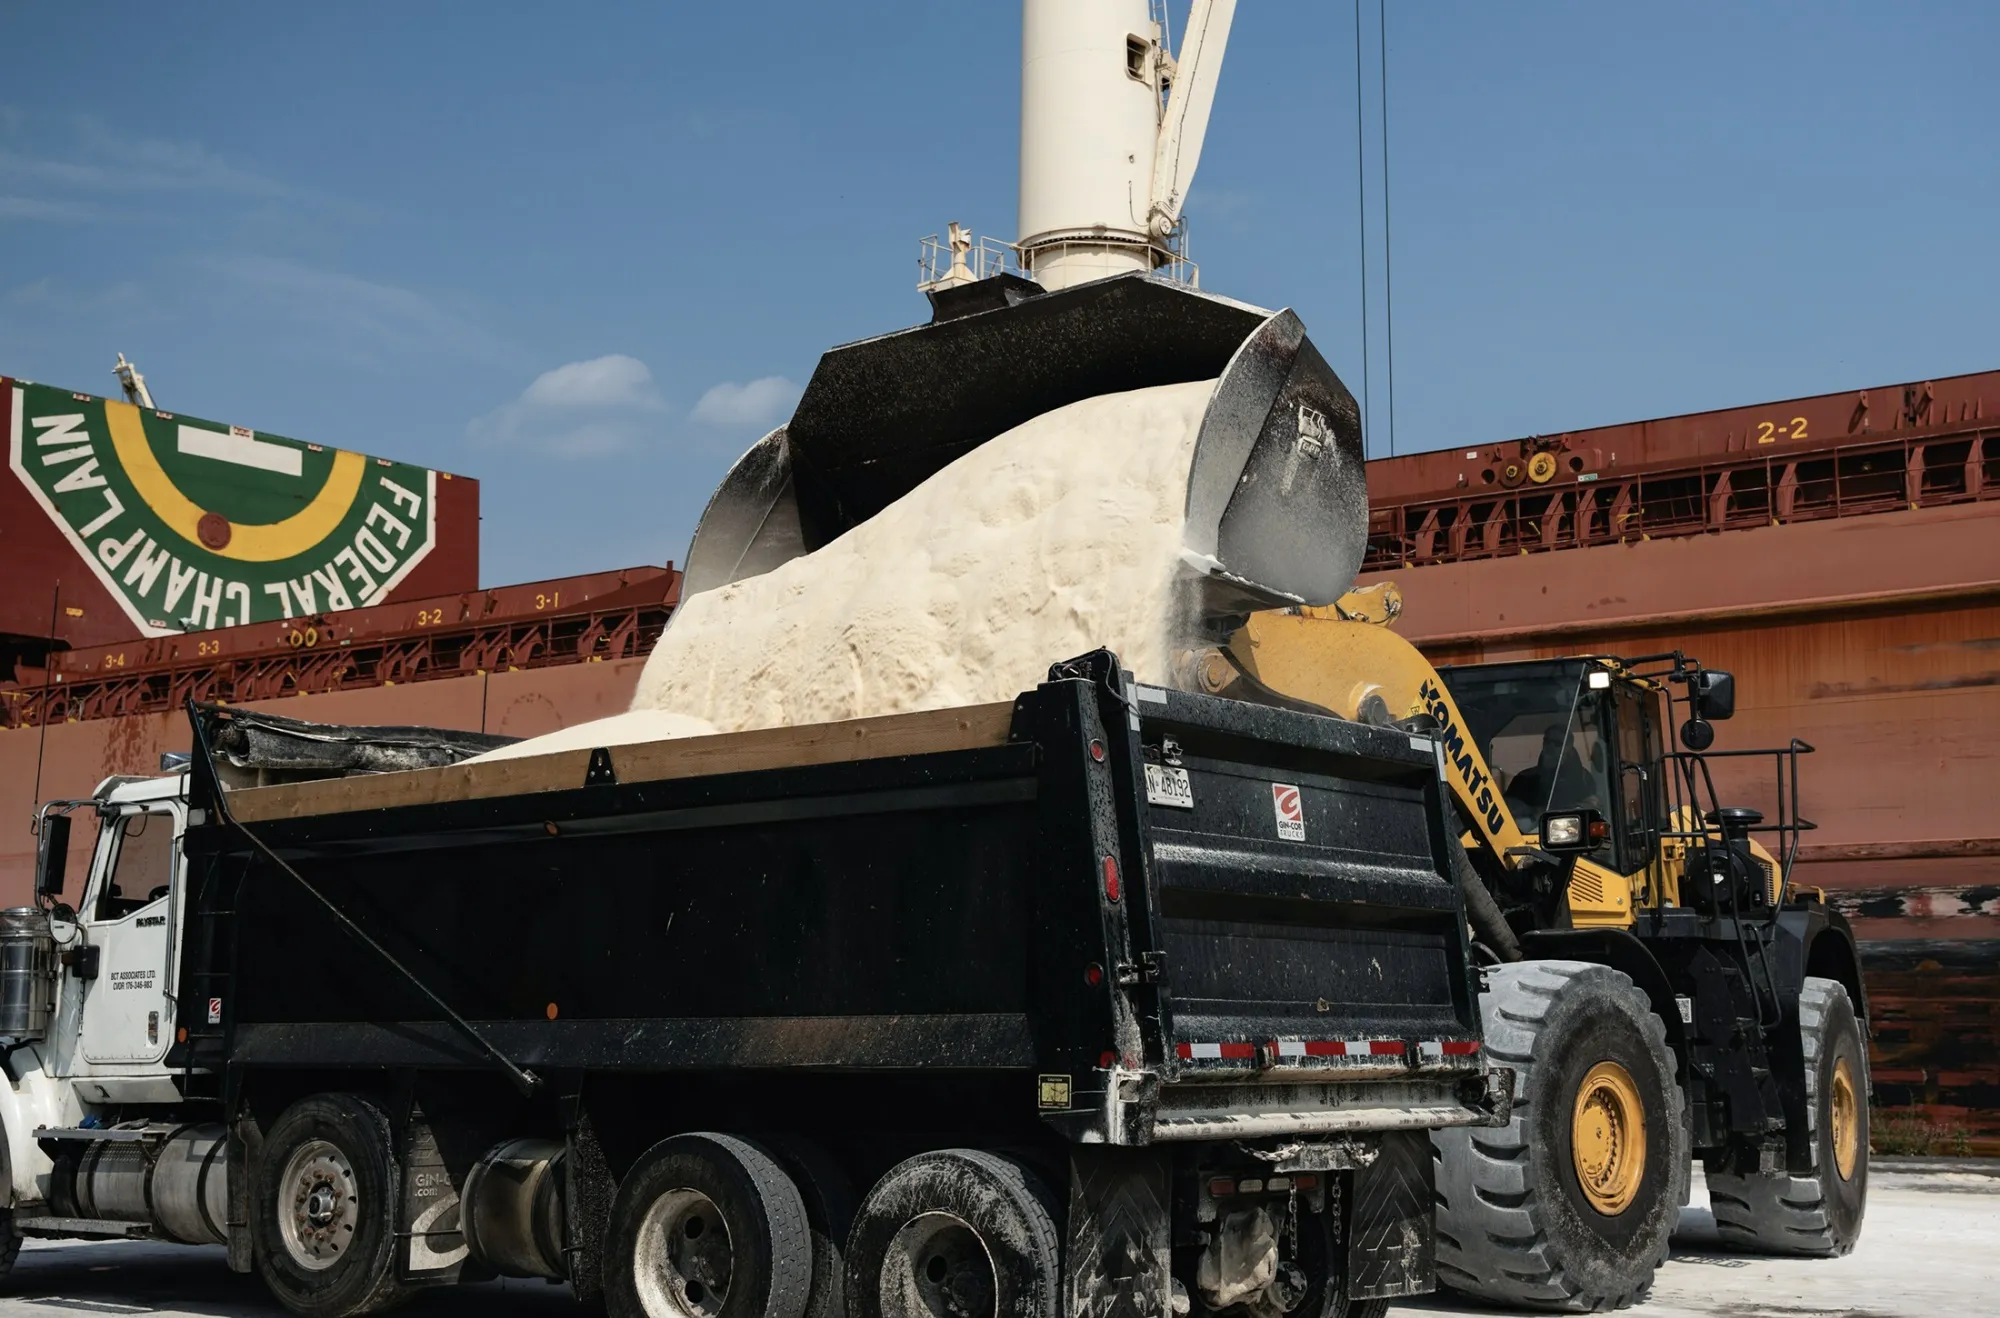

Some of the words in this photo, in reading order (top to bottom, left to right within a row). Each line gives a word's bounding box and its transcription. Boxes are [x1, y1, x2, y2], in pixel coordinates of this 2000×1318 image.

[1757, 416, 1808, 444] 2-2
[31, 413, 250, 630] CHAMPLAIN
[263, 476, 422, 619] FEDERAL
[535, 591, 559, 610] 3-1
[417, 608, 442, 626] 3-2
[197, 639, 219, 656] 3-3
[105, 653, 125, 669] 3-4
[1419, 678, 1505, 836] KOMATSU
[1161, 776, 1191, 798] 48192
[1279, 820, 1303, 831] GIN-COR
[1280, 829, 1304, 839] TRUCKS
[119, 970, 146, 980] ASSOCIATES
